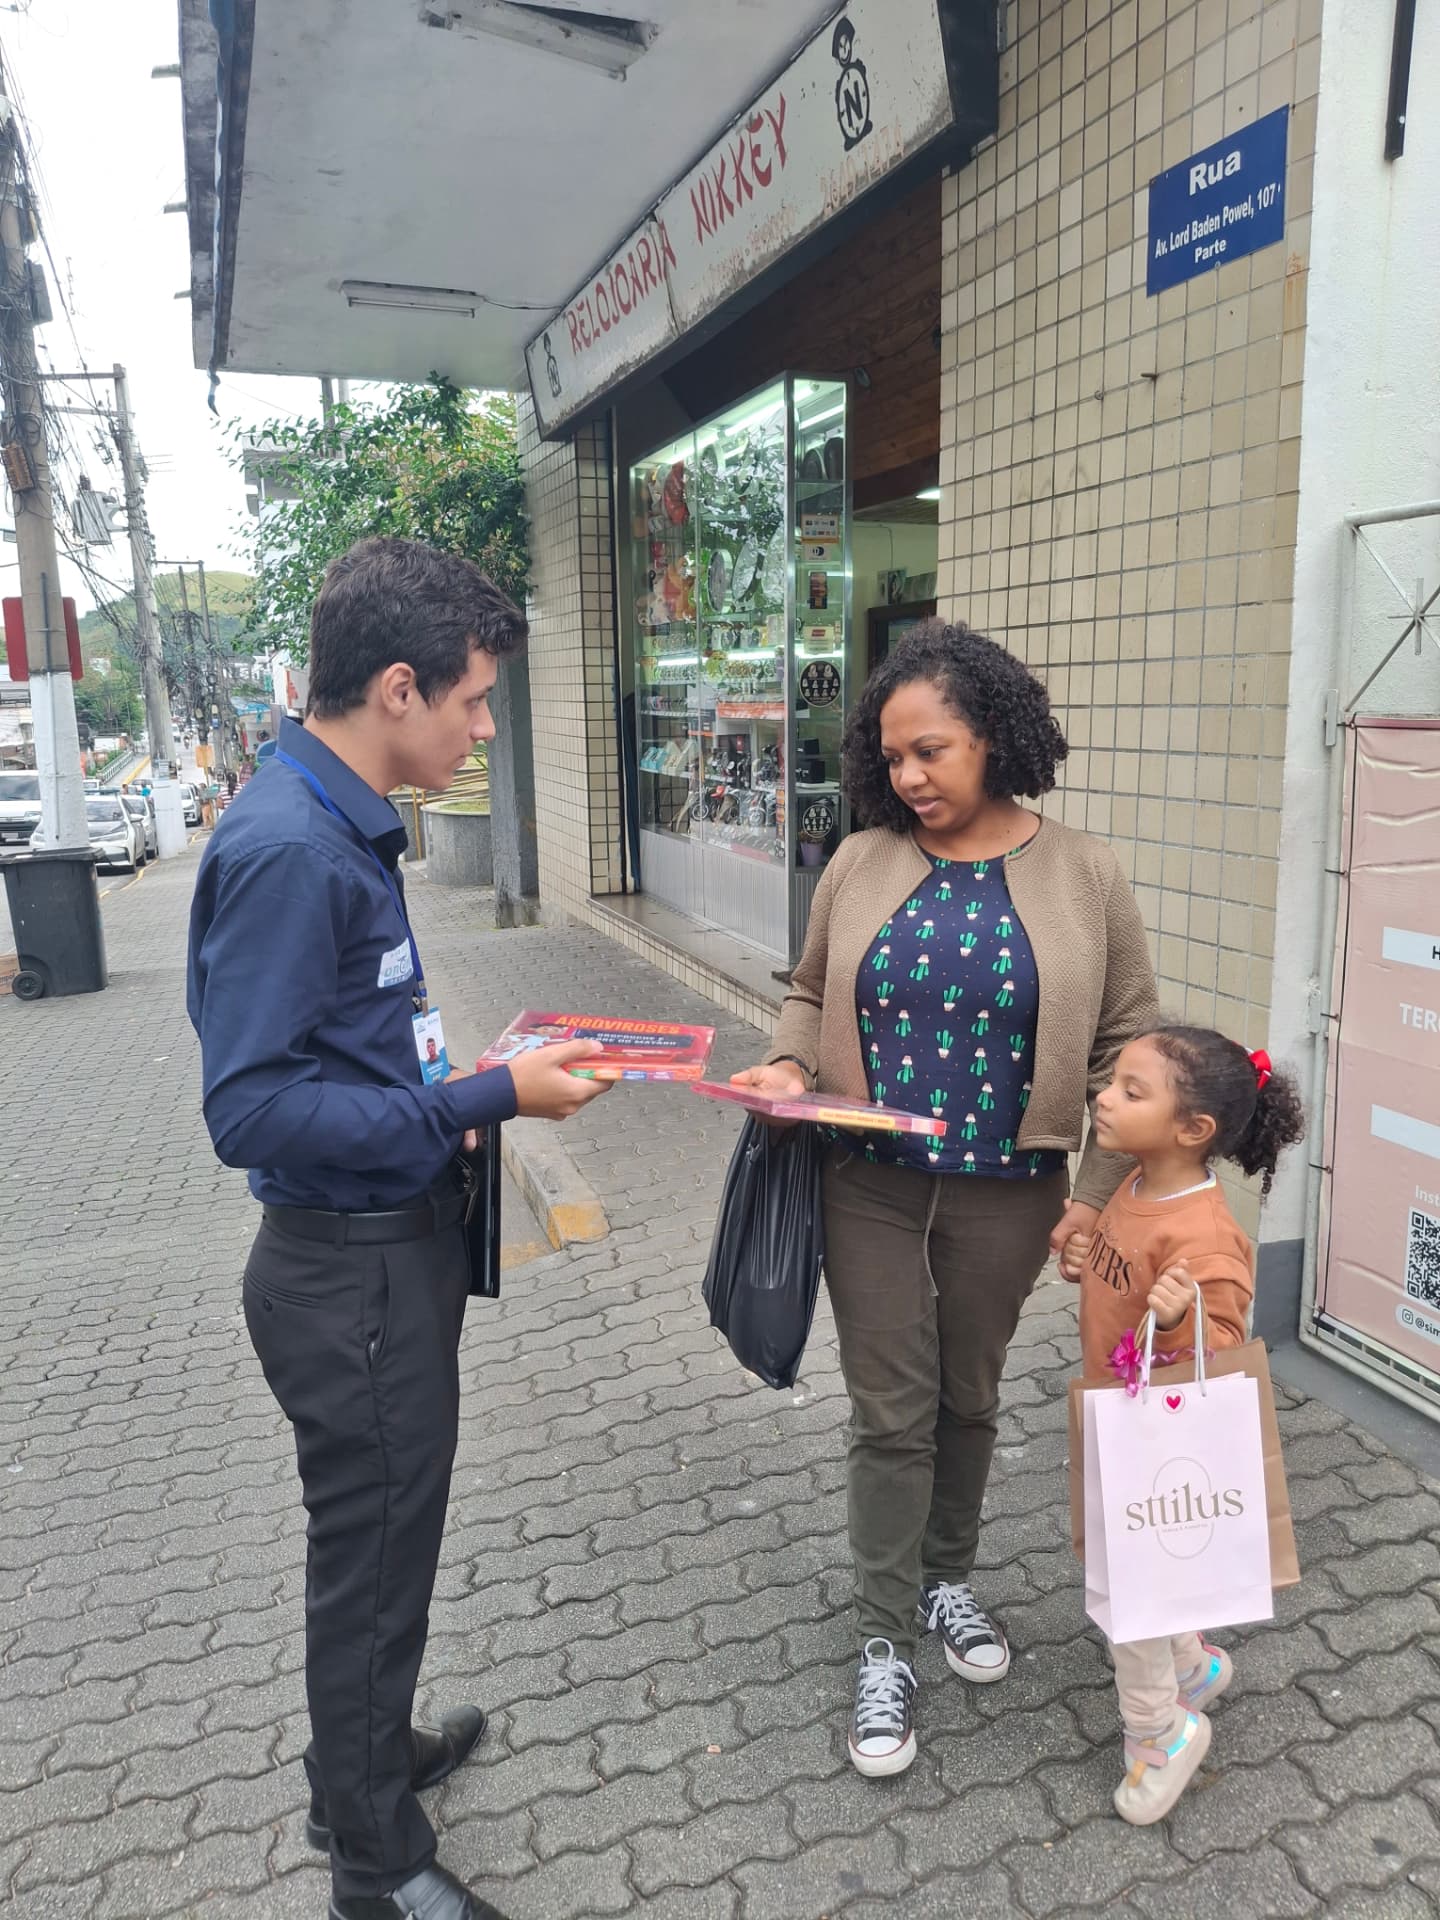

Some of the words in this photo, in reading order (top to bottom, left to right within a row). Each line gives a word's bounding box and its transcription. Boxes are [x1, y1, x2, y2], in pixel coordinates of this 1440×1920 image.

[1189, 150, 1241, 196] Rua
[567, 219, 677, 356] RELOJOARIA
[689, 93, 788, 246] NIKKEY
[1155, 238, 1168, 259] Av.
[1169, 224, 1190, 252] Lord
[1191, 215, 1220, 241] Baden
[1222, 194, 1255, 228] Powel,
[1194, 239, 1227, 263] Parte
[555, 1016, 681, 1034] ARBOVIROSES
[1399, 1002, 1440, 1033] TER
